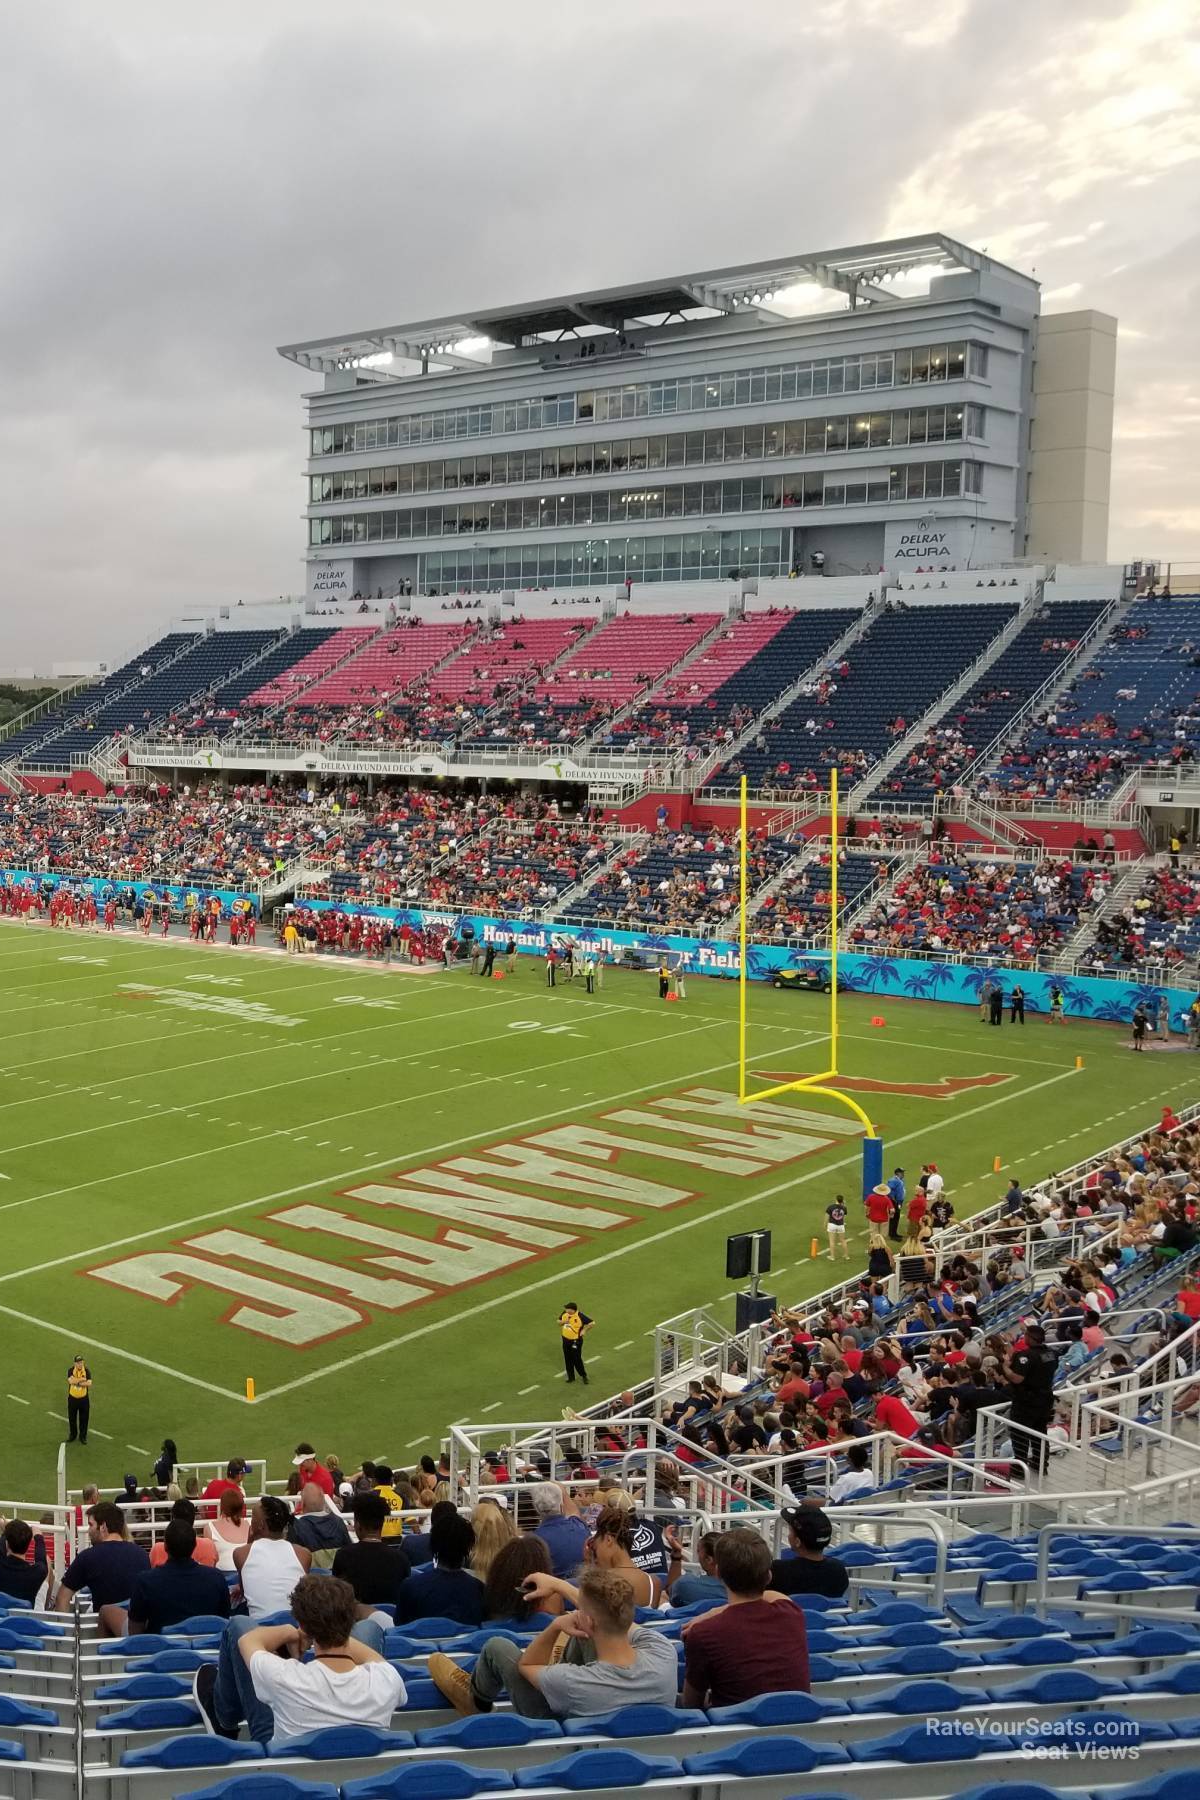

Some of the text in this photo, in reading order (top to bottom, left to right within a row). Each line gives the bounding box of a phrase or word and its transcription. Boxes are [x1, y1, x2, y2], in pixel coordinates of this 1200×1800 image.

[900, 533, 947, 545] DELRAY
[894, 546, 951, 558] ACURA
[316, 571, 345, 580] DELRAY
[313, 581, 347, 590] ACURA
[321, 762, 415, 773] DELRAY HYUNDAI DECK
[565, 770, 598, 778] DELRAY
[484, 924, 545, 947] Howard
[78, 1085, 877, 1349] ATLANTIC
